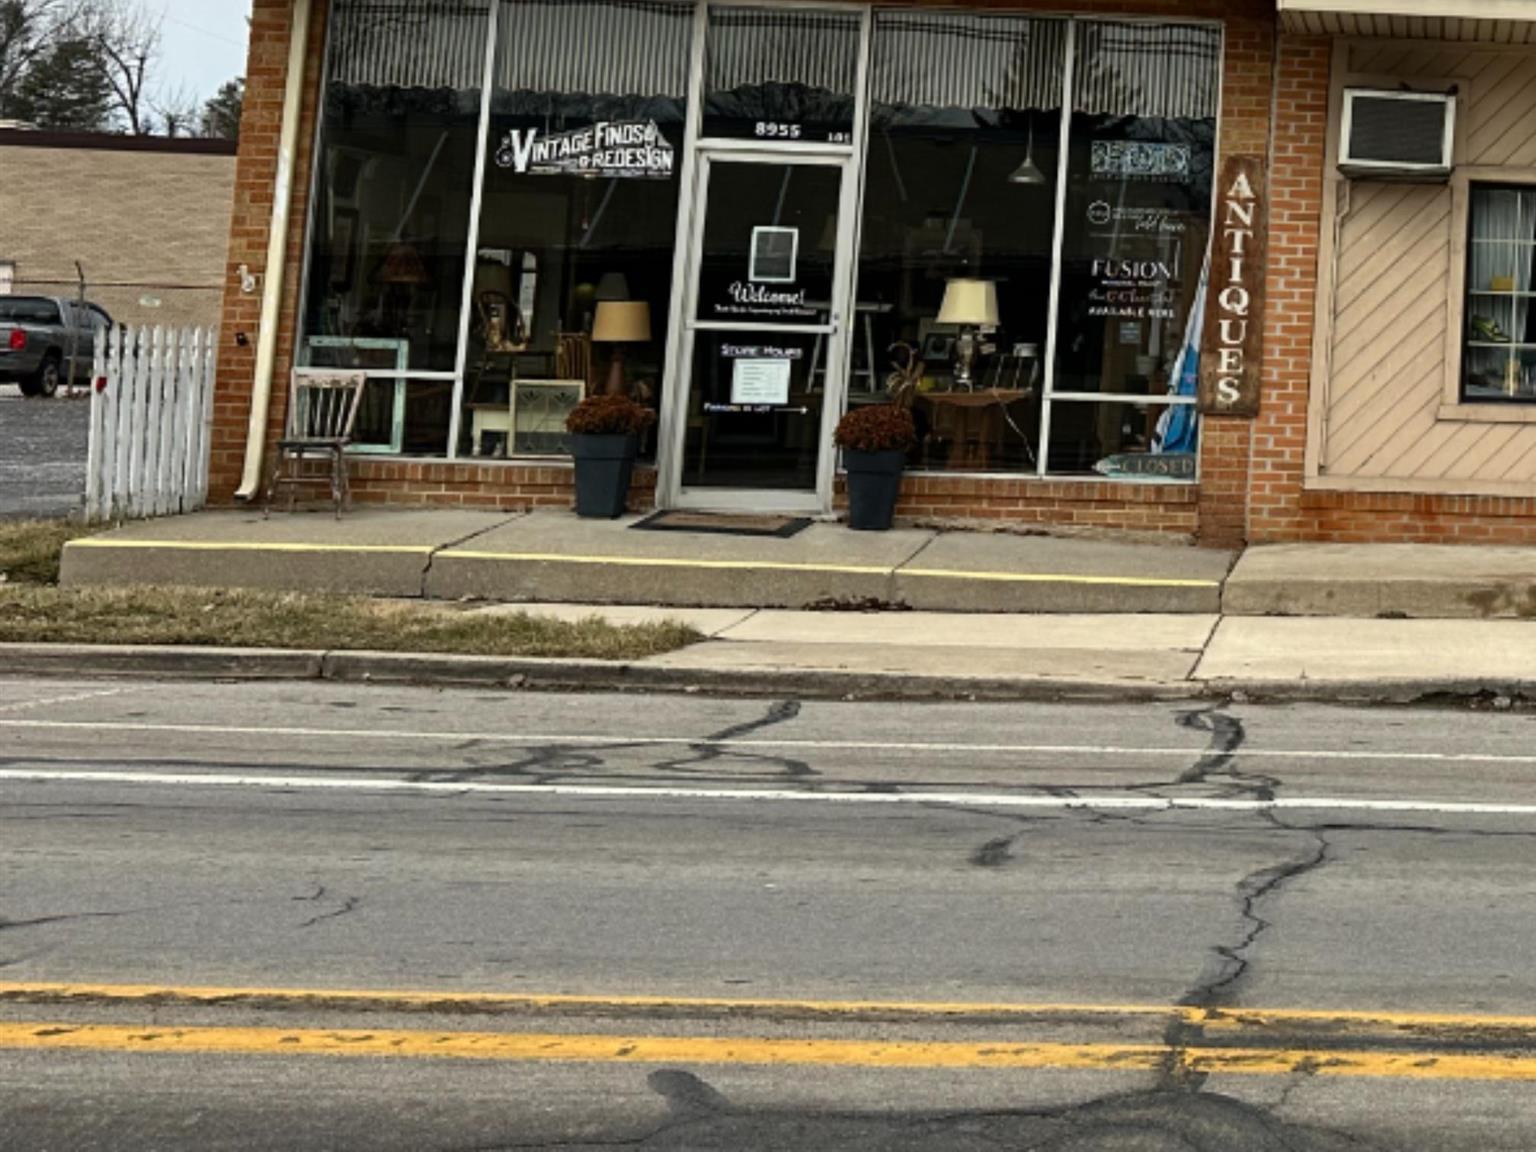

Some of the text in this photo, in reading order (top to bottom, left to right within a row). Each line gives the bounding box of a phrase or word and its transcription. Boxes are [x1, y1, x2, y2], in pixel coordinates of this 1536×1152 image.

[755, 121, 801, 138] 8955
[510, 121, 643, 173] VINTAGE FINDS
[592, 148, 674, 170] REDESIGN
[1091, 259, 1170, 279] FUSION
[1216, 171, 1256, 404] ANTIQUES
